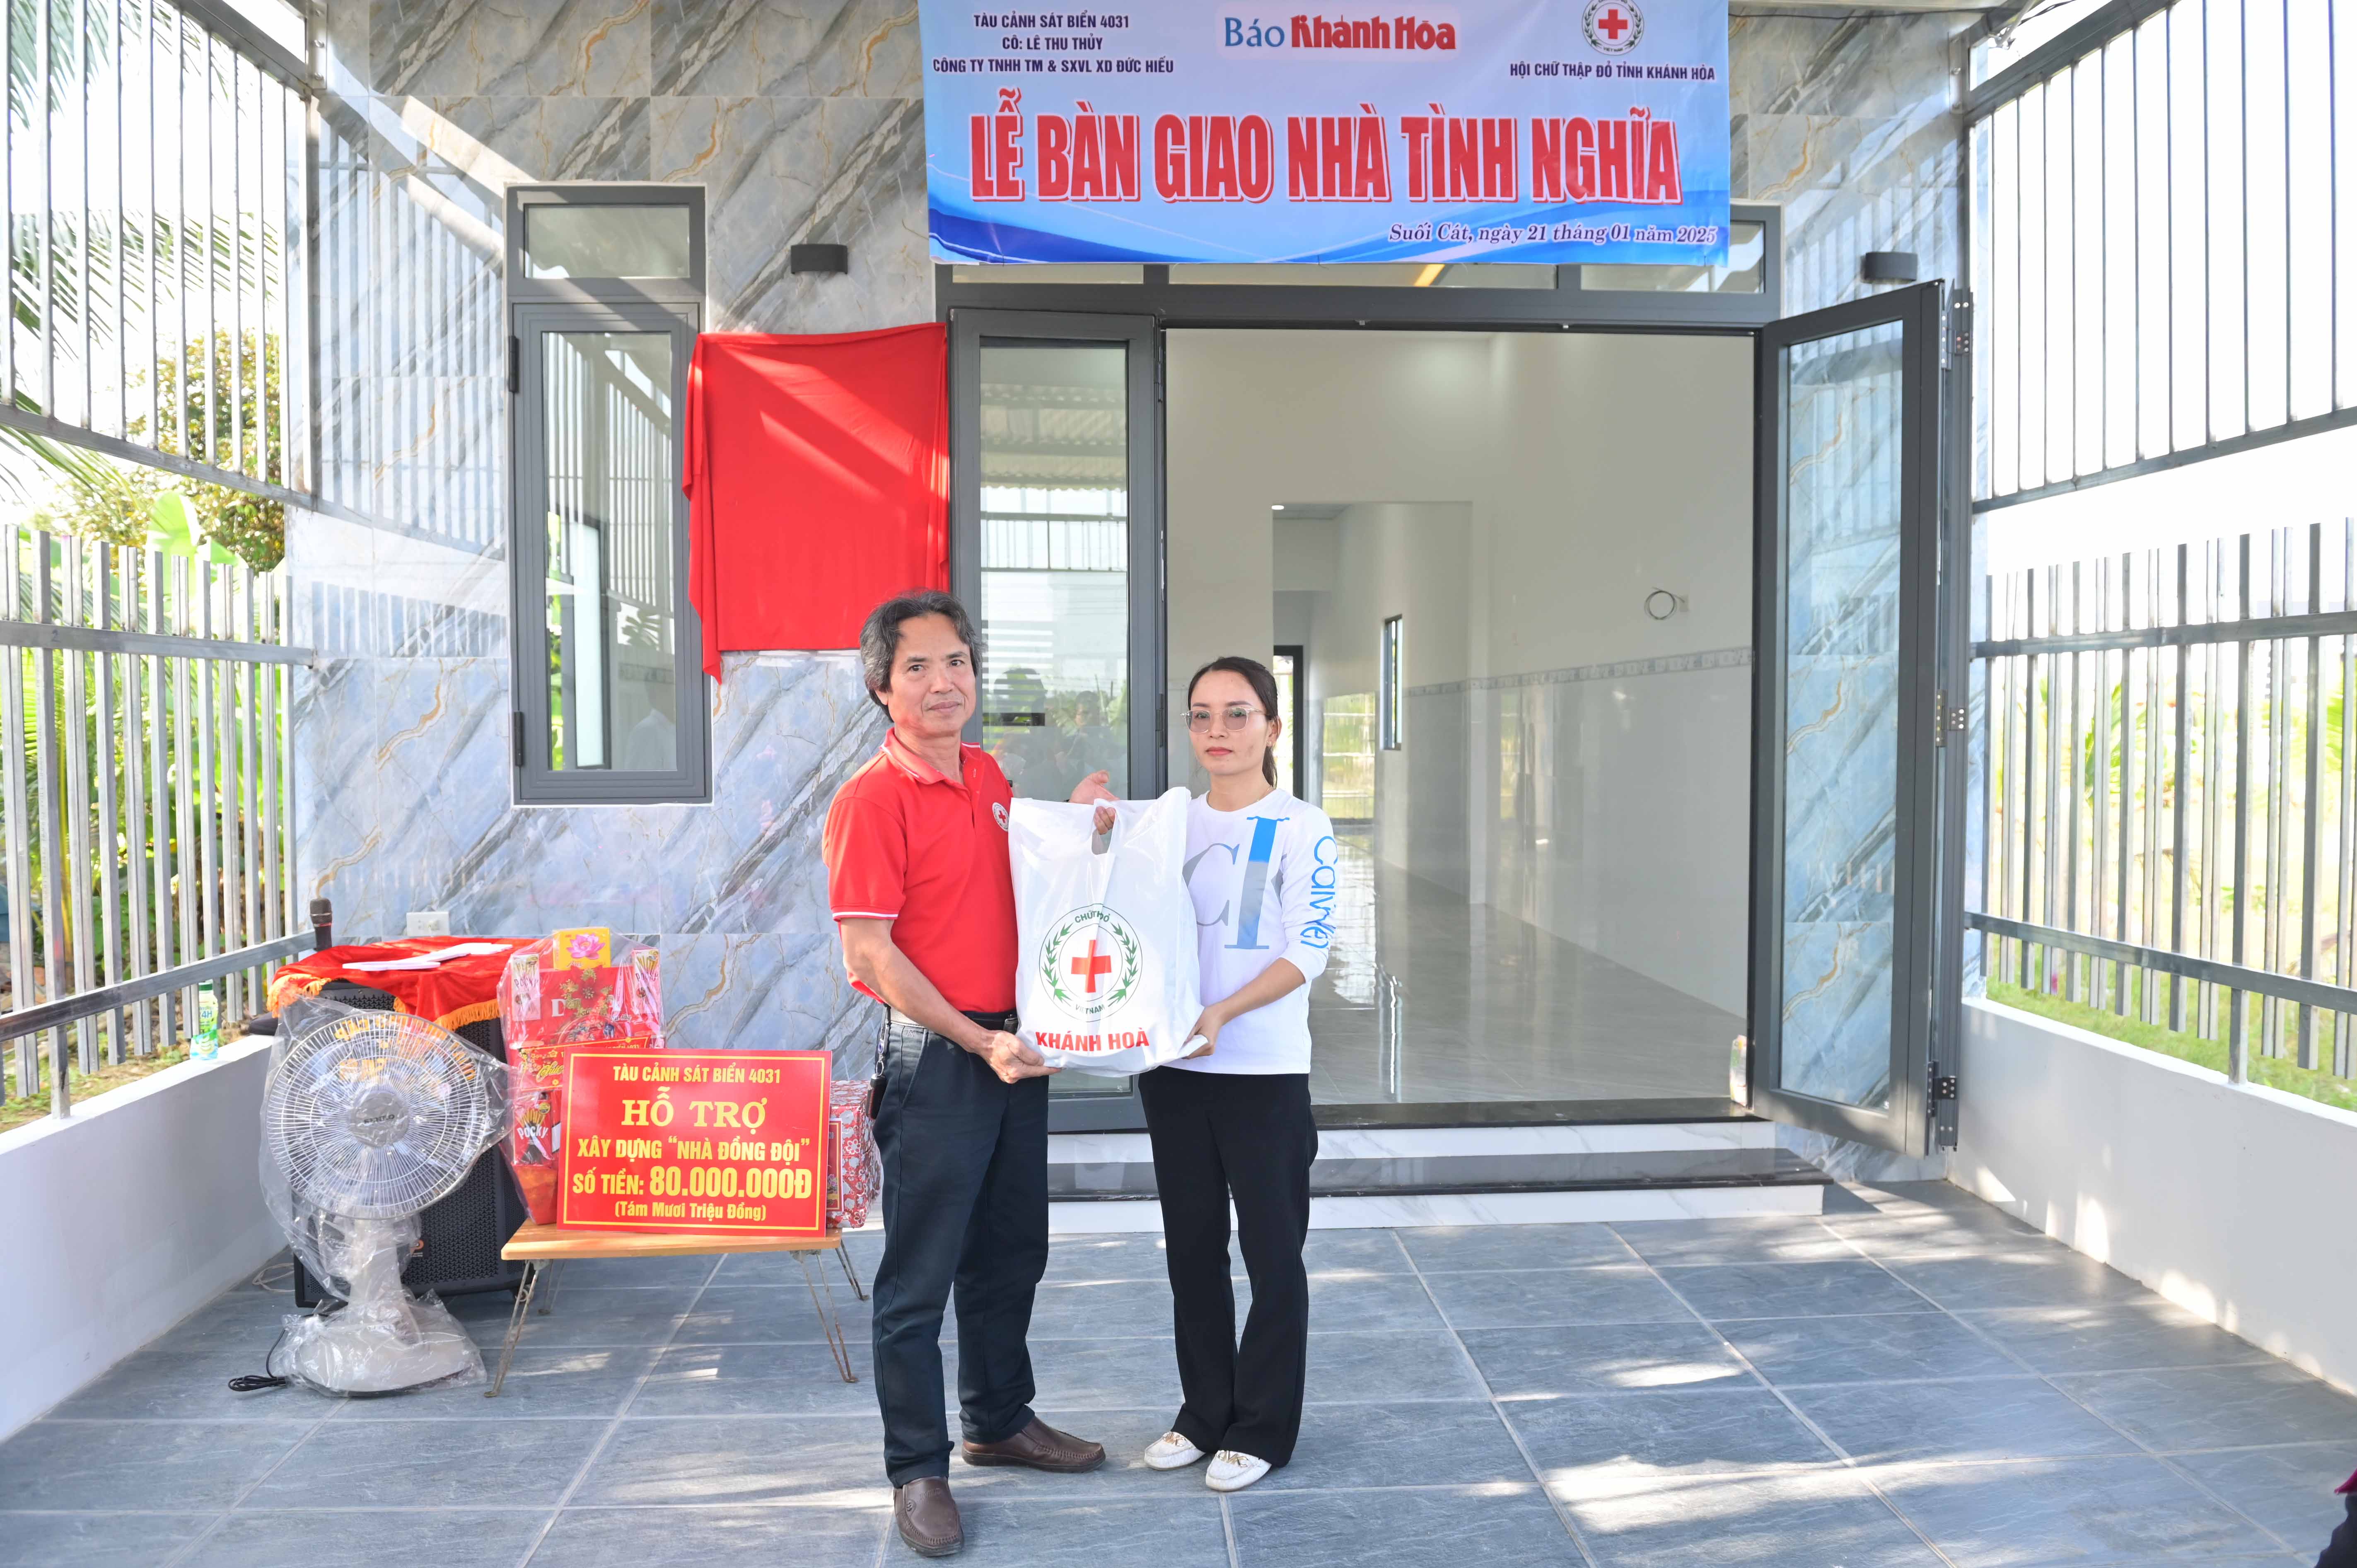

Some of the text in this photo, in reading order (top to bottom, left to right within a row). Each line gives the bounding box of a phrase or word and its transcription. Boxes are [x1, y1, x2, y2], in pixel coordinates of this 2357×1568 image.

[974, 10, 1129, 28] TÀU CẢNH SÁT BIỂN 4031
[1002, 33, 1103, 50] CÔ: LÊ THU THỦY
[1224, 17, 1285, 47] Báo
[1290, 14, 1390, 48] Khánh
[933, 55, 1174, 72] CÔNG TY TNHH TM & SXVL XD ĐỨC HIẾU
[1510, 60, 1715, 80] HỘI CHỮ THẬP ĐỎ TỈNH KHÁNH HÒA
[970, 87, 1683, 205] LỄ BÀN GIAO NHÀ TÌNH NGHĨA
[1390, 222, 1717, 244] Suối Cát, ngày 21 tháng 01 năm 2025
[1035, 1027, 1150, 1051] KHÁNH HOÀ
[613, 1062, 780, 1083] TÀU CẢNH SÁT BIỂN 4031
[621, 1086, 768, 1134] HỖ TRỢ
[577, 1135, 611, 1157] XÂY
[616, 1138, 662, 1162] DỰNG
[718, 1136, 766, 1161] ĐỒNG
[572, 1166, 812, 1199] SỐ TIỀN: 80.000.000Đ
[615, 1201, 766, 1221] (Tám Mươi Triệu Đồng)
